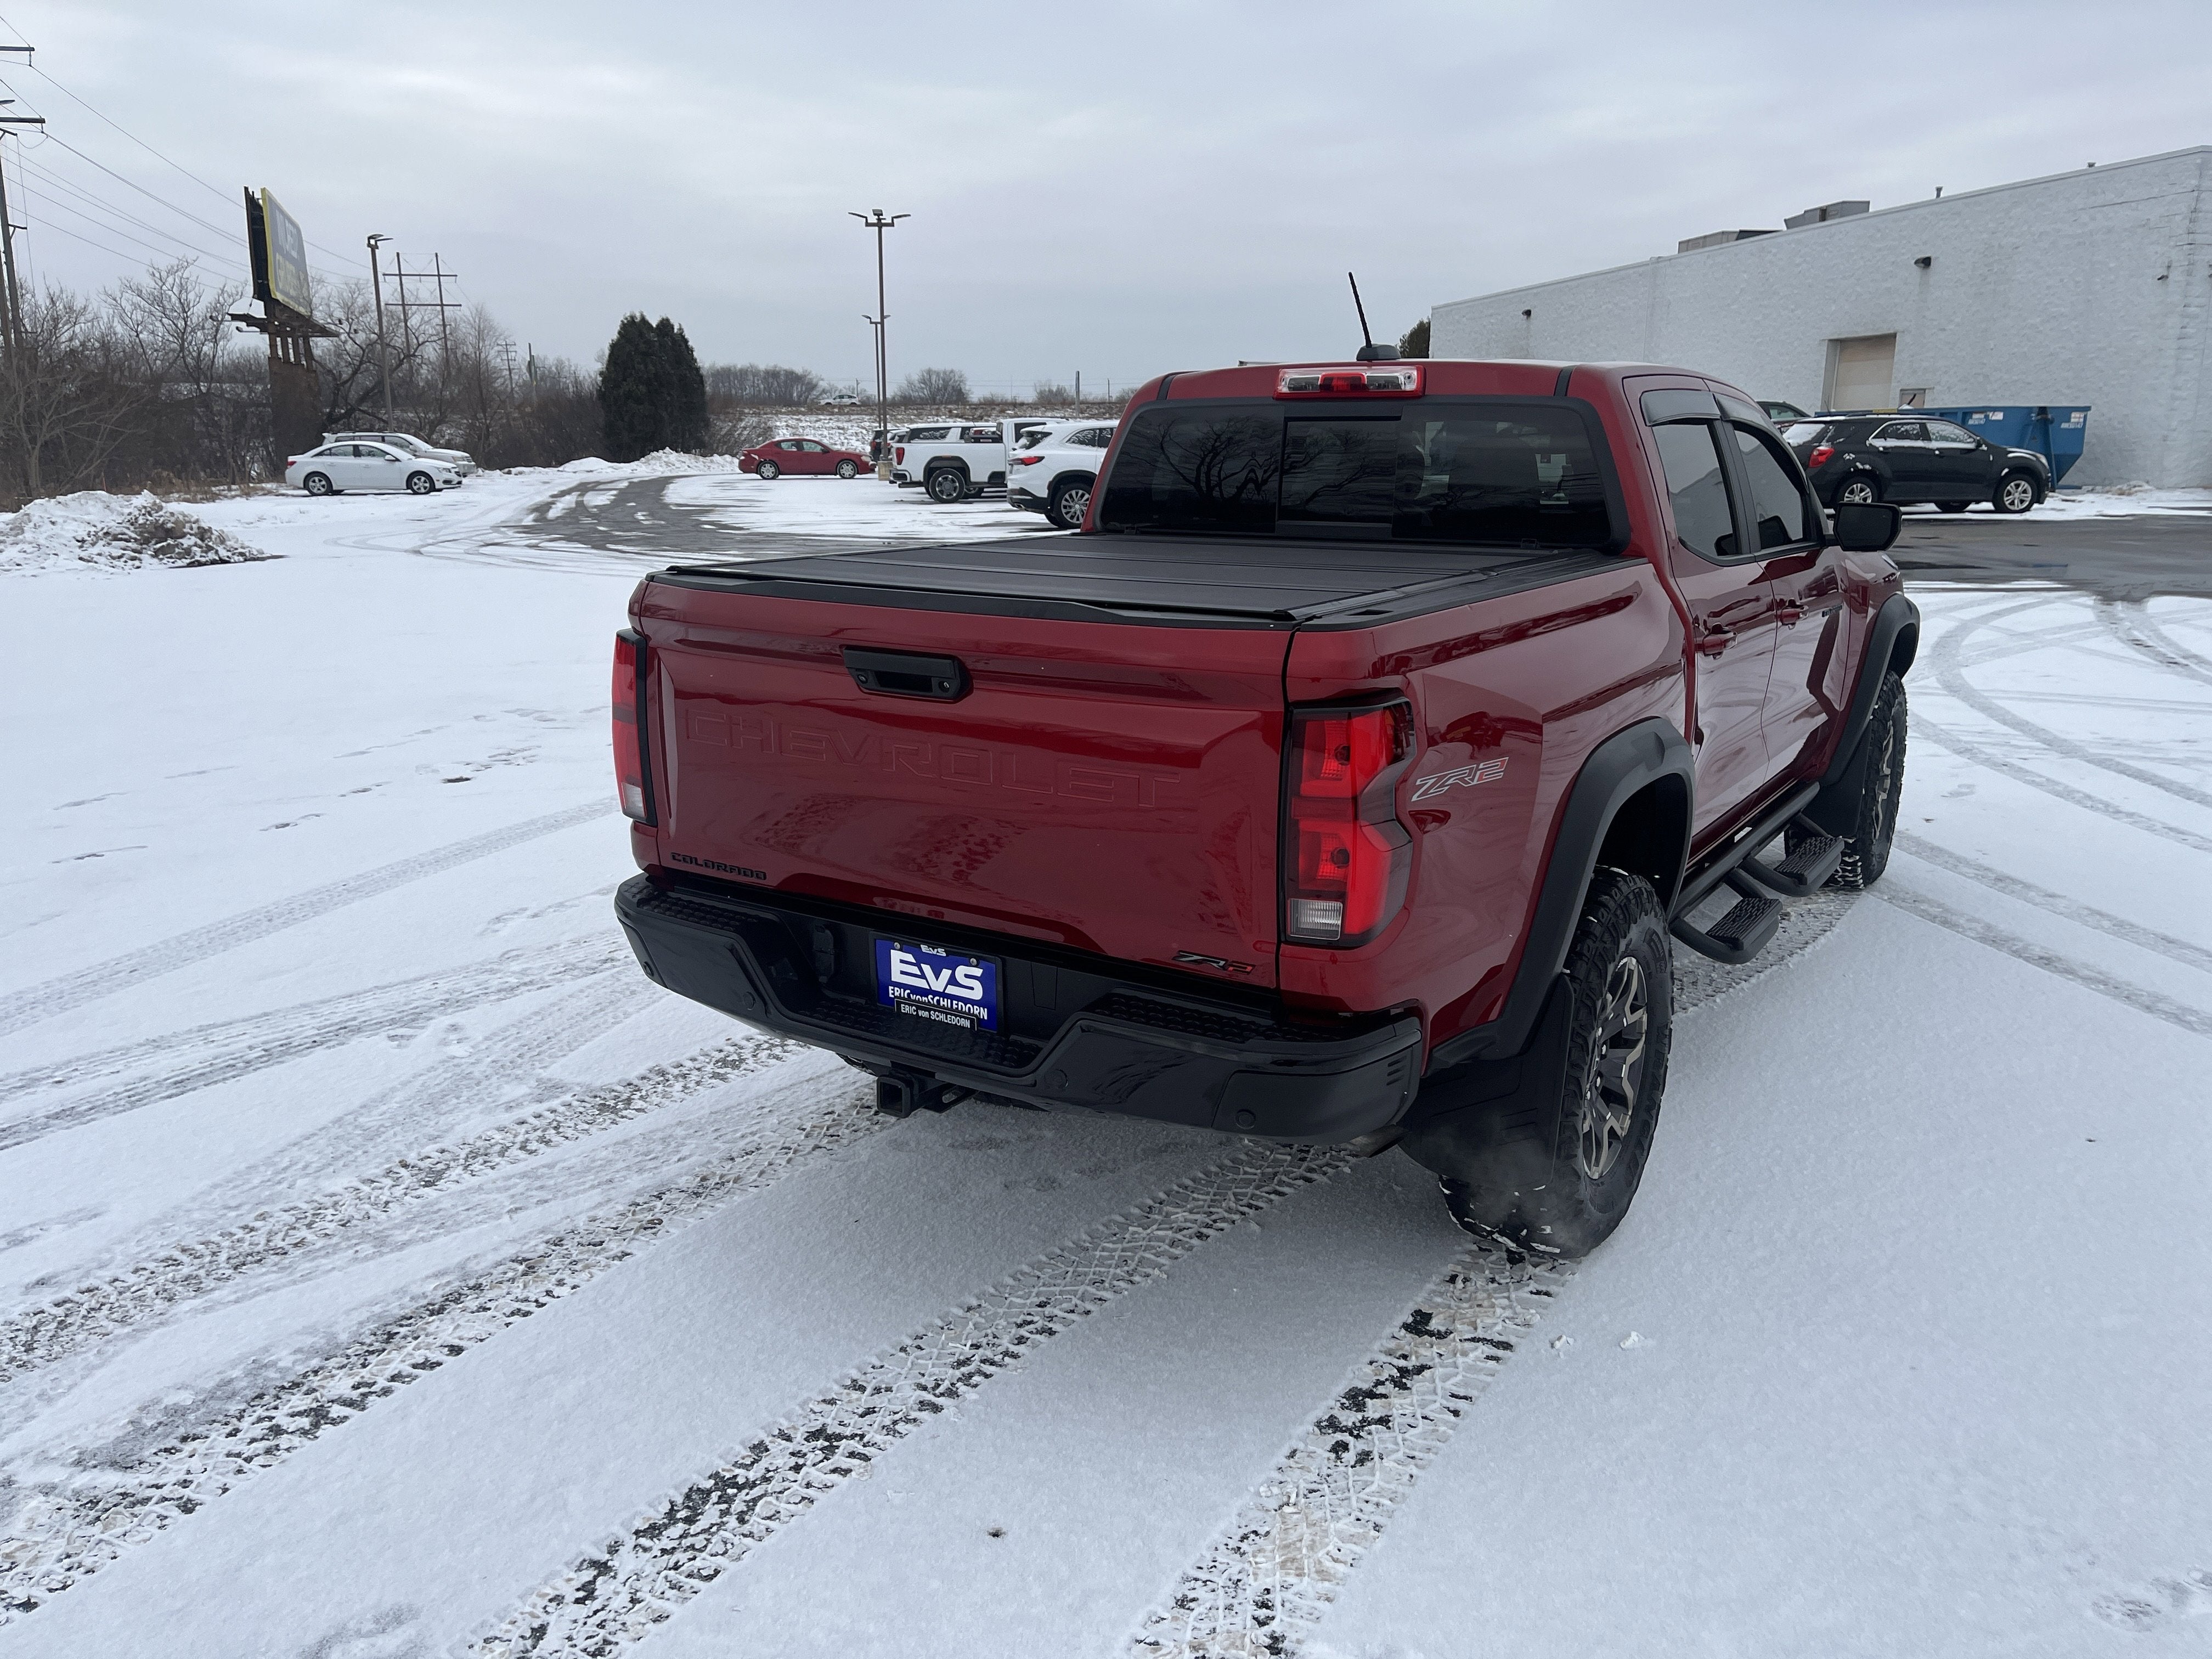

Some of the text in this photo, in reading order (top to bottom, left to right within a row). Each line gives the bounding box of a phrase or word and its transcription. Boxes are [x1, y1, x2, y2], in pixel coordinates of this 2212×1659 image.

[686, 708, 1181, 808] CHEVROLET
[1411, 757, 1509, 802] ZR2
[670, 852, 767, 881] COLORADO
[1171, 950, 1256, 975] ZR2
[901, 1003, 970, 1029] ERIC von SCHLEDORN
